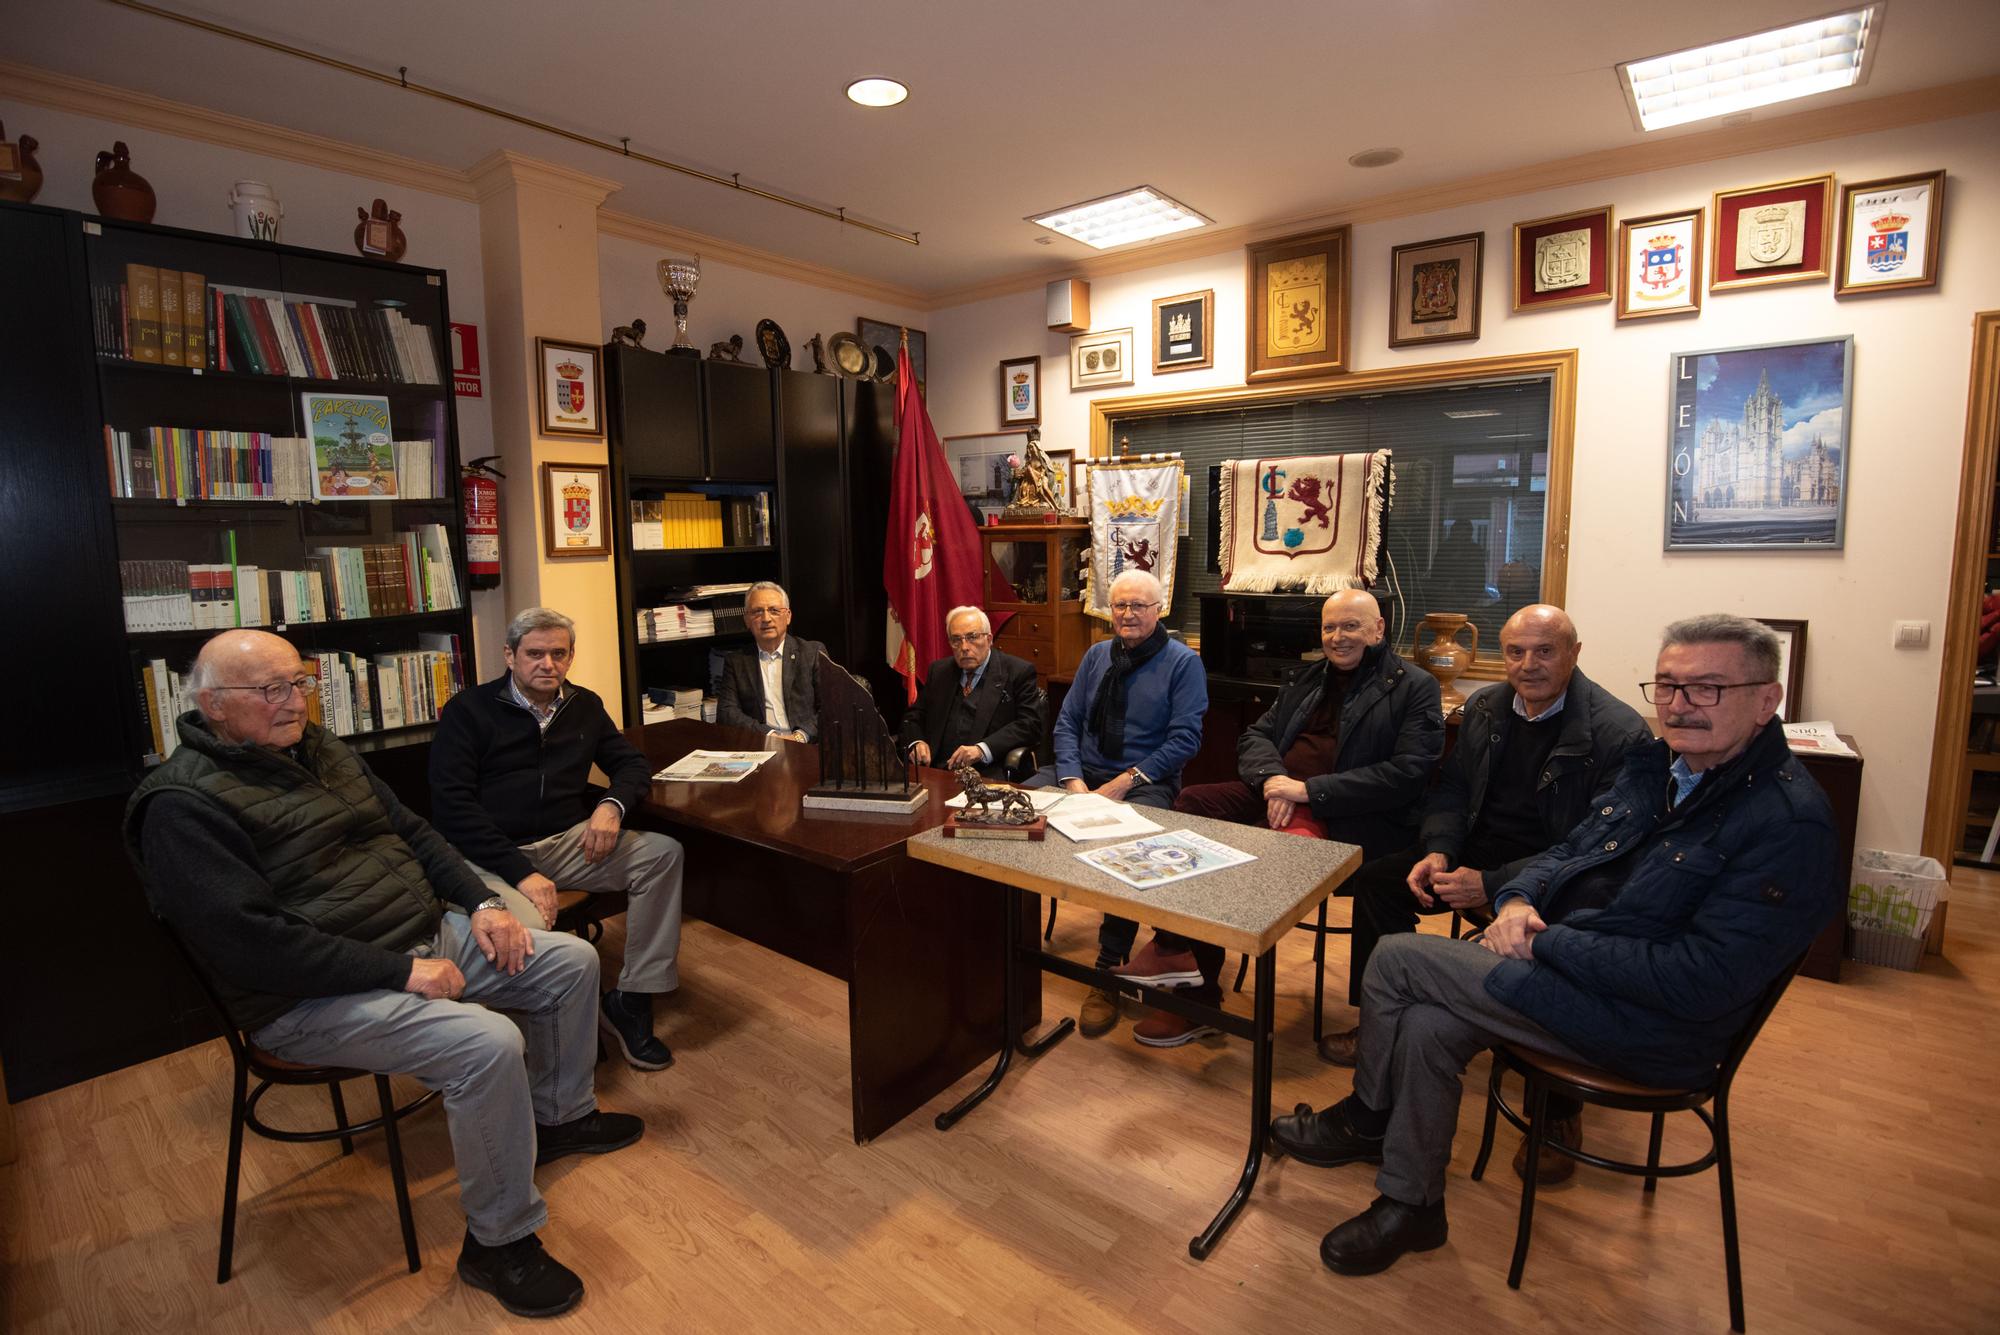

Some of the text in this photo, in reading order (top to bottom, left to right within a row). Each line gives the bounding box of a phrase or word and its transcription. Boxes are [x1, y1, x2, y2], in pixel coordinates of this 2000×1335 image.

[454, 380, 479, 393] NTOR
[1673, 356, 1693, 523] LEÓN
[1791, 727, 1818, 735] NDO
